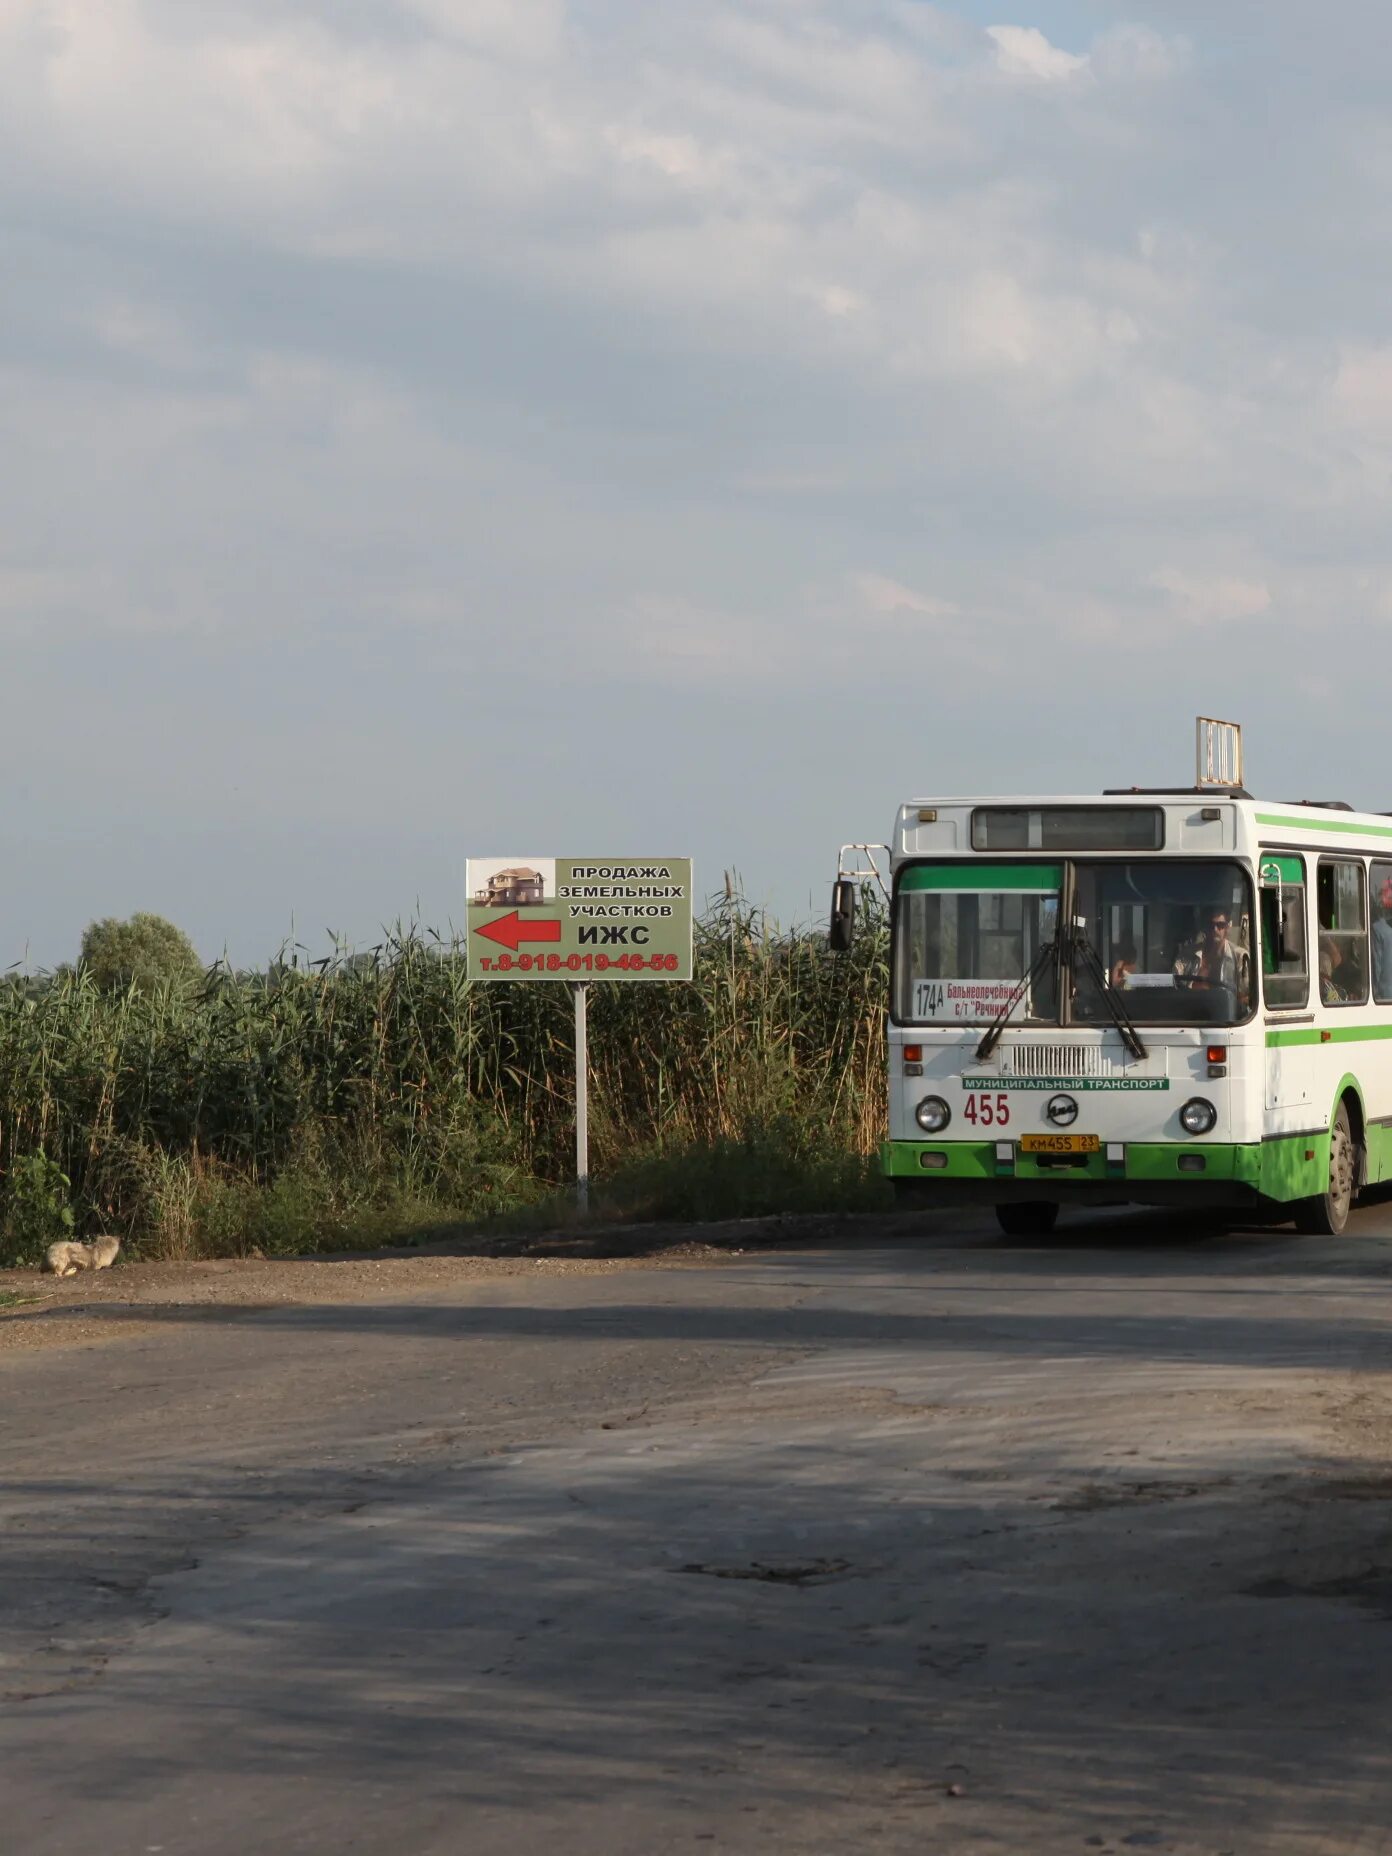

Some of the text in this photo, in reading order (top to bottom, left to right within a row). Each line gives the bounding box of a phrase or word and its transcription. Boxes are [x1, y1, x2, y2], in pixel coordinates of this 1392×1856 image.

[572, 866, 670, 880] ПРОДАЖА
[559, 886, 683, 898] ЗЕМЕЛЬНЫХ
[570, 905, 672, 917] УЧАСТКОВ
[578, 925, 650, 945] ИЖС
[965, 1077, 1165, 1090] МУНИЦИПАЛЬНЫЙ ТРАНСПОРТ
[964, 1094, 1010, 1125] 455
[1081, 1136, 1094, 1146] 23
